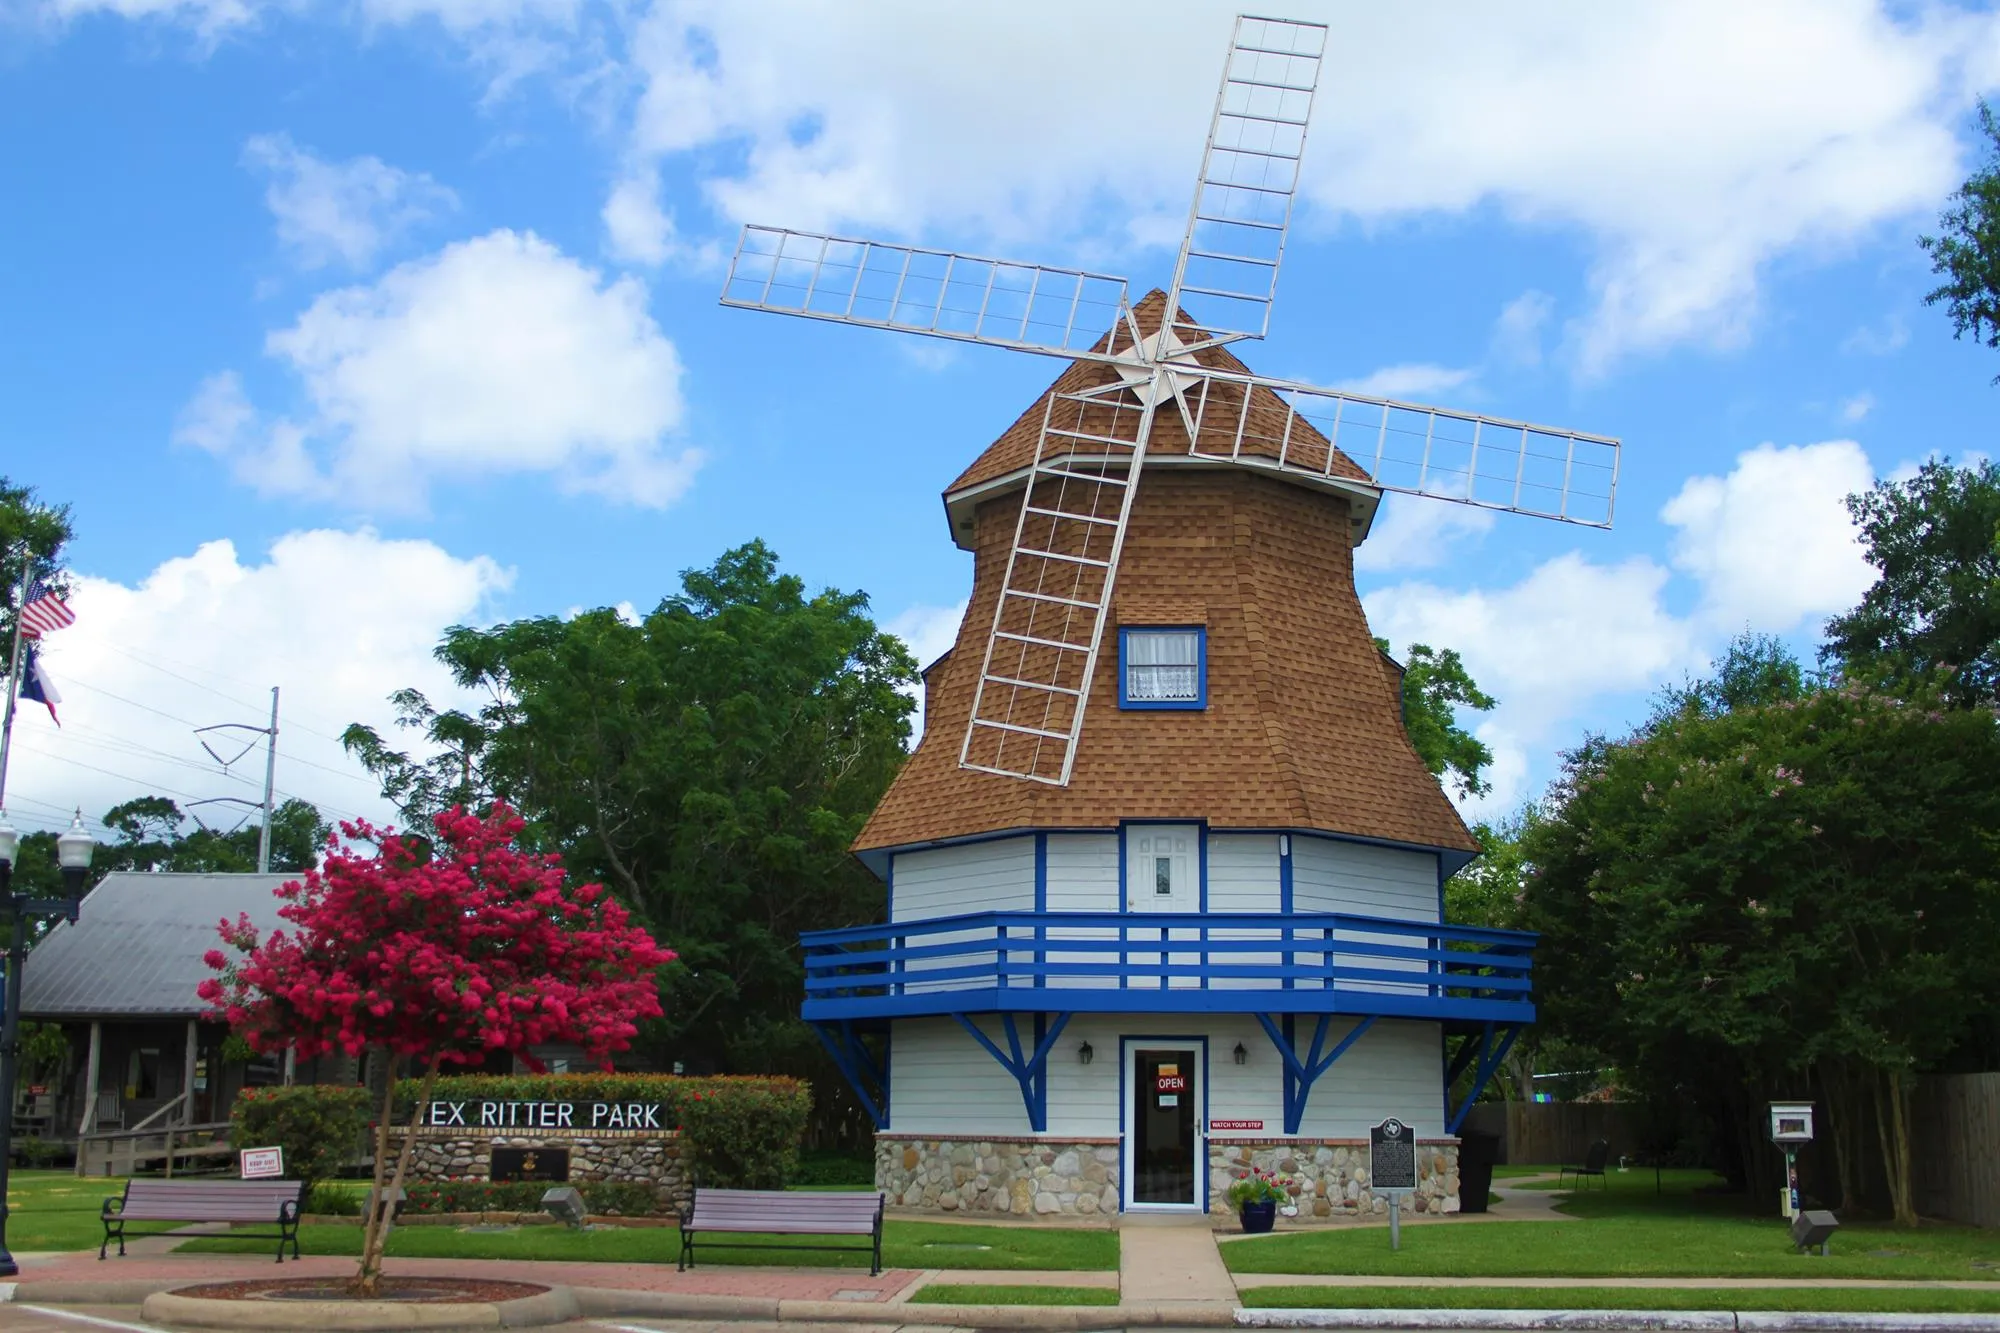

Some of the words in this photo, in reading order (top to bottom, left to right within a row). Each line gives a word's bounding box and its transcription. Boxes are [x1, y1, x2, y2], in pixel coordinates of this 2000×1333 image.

[1158, 1078, 1184, 1089] OPEN
[481, 1102, 573, 1127] RITTER
[592, 1103, 660, 1128] PARK
